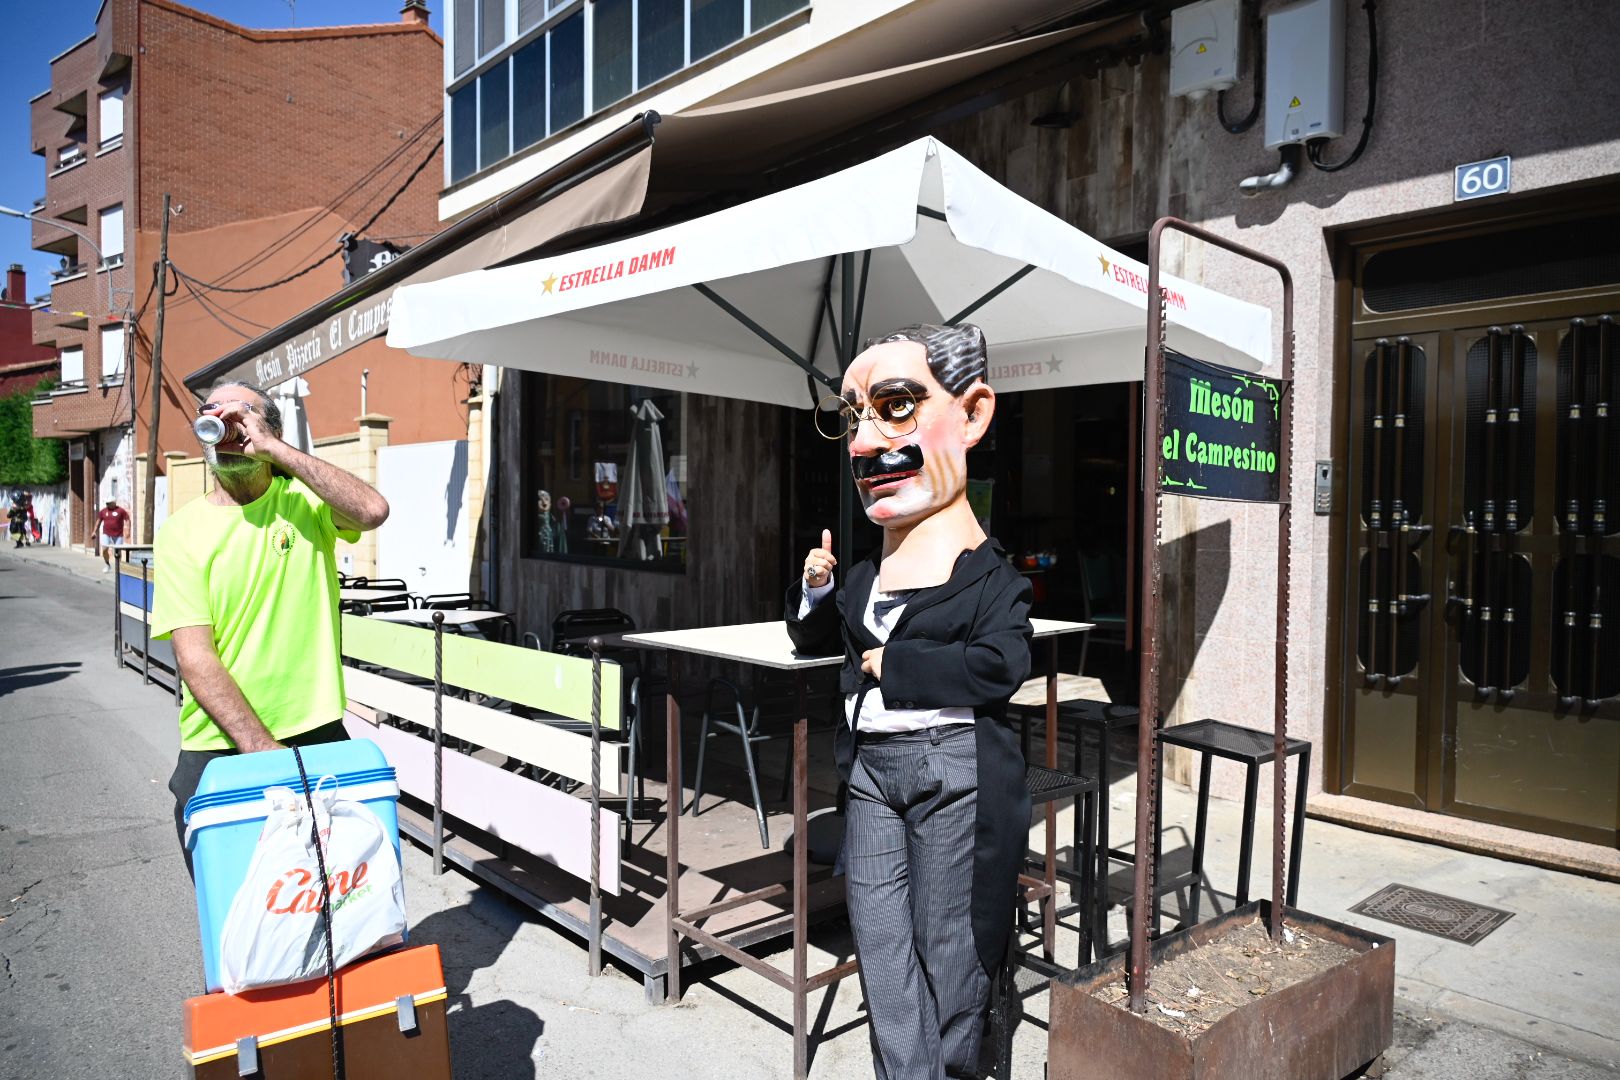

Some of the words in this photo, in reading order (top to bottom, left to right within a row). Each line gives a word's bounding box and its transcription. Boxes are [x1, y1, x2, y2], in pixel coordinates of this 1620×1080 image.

[1461, 163, 1503, 194] 60
[559, 260, 625, 292] ESTRELLA
[628, 246, 676, 275] DAMM
[255, 351, 282, 386] Mesón
[285, 330, 321, 375] Pizzería
[330, 318, 342, 351] El
[348, 297, 393, 341] Campes
[1189, 377, 1254, 424] Mesón
[1162, 428, 1180, 460] el
[1185, 431, 1276, 473] Campesino
[331, 884, 373, 912] arket
